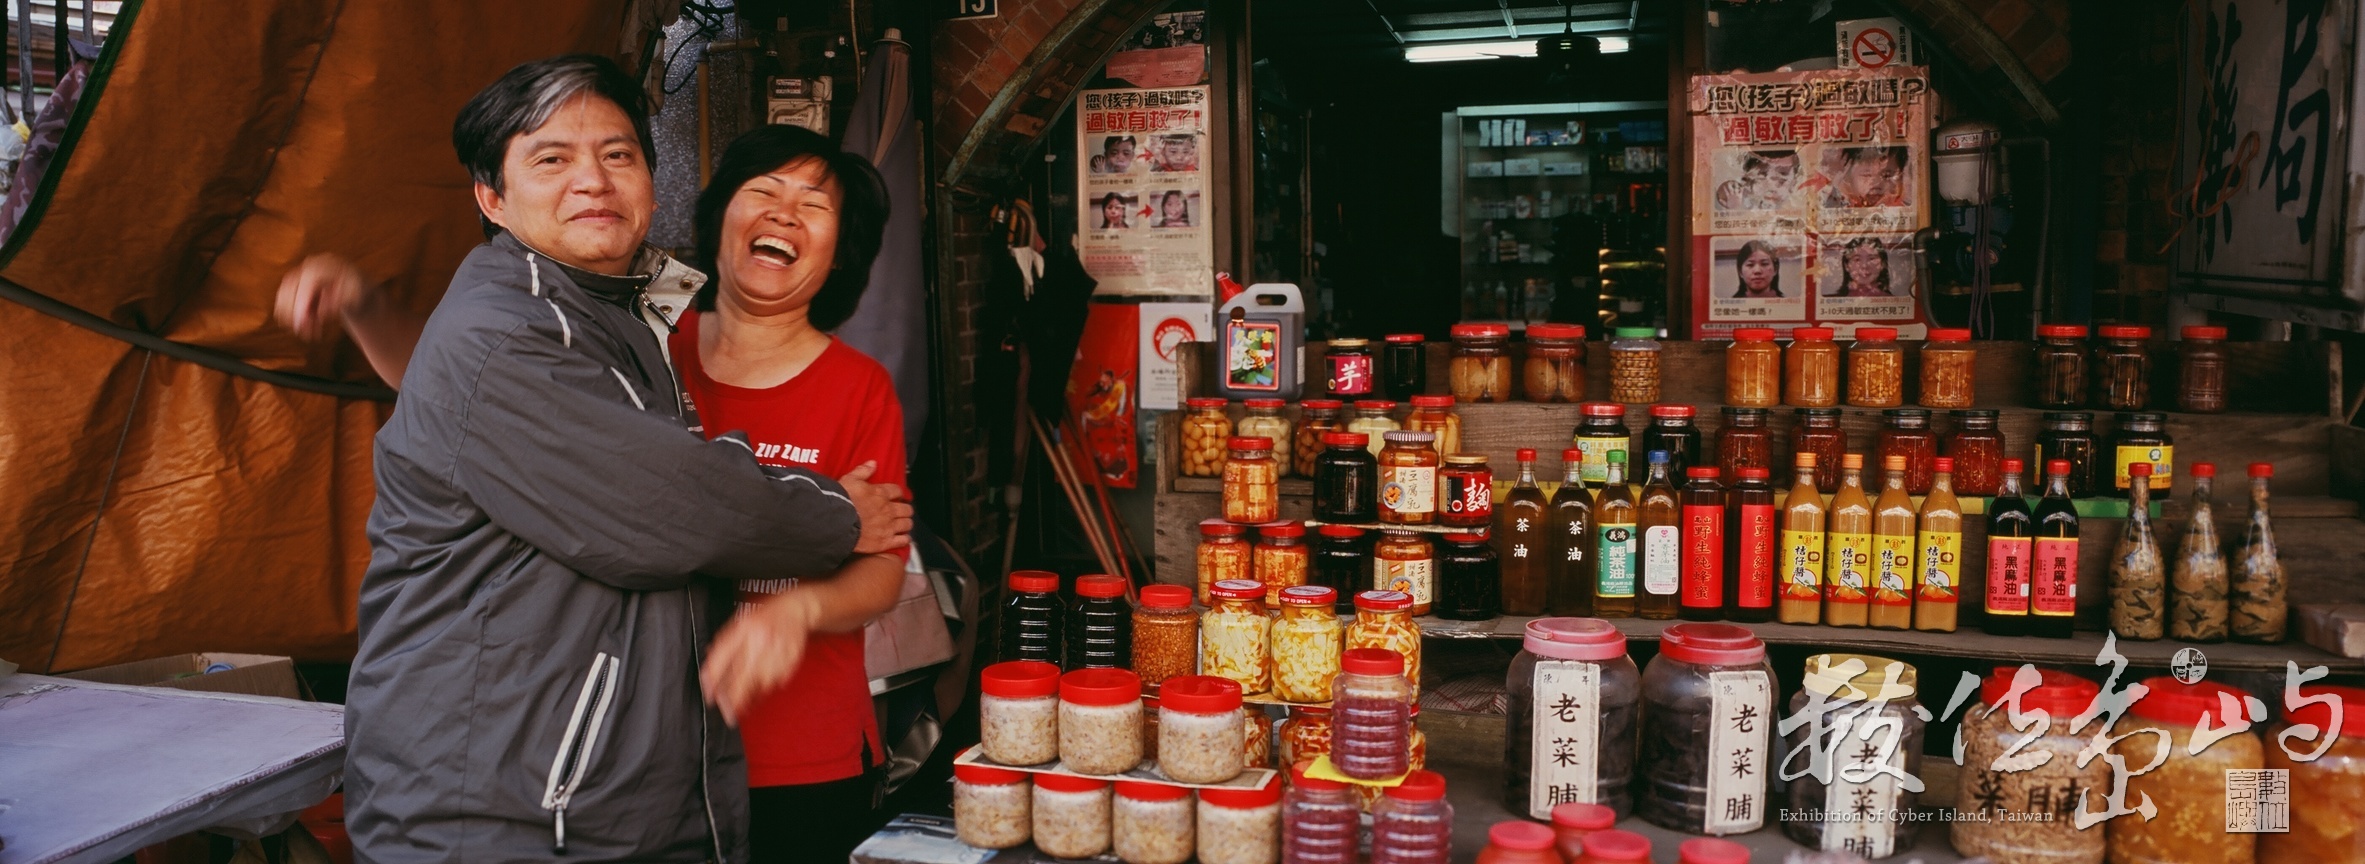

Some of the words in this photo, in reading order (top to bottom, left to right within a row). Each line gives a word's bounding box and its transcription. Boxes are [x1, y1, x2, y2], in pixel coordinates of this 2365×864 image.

[1707, 78, 1929, 113] 您(孩子)過敏嗎?
[1086, 110, 1201, 133] 過敏有救了!
[1722, 112, 1909, 146] 過敏有救了!
[1338, 361, 1361, 391] 芋
[755, 442, 782, 459] ZIP
[1407, 470, 1421, 510] 豆腐乳
[1513, 517, 1530, 558] 茶油
[1567, 520, 1583, 561] 茶油
[1609, 546, 1626, 579] 純茶油
[1693, 524, 1712, 600] 野生純蜂蜜
[1752, 524, 1770, 599] 野生純蜂蜜
[1793, 545, 1807, 578] 桔仔醬
[1841, 547, 1853, 579] 桔仔醬
[1879, 549, 1894, 582] 桔仔醬
[1925, 546, 1939, 579] 桔仔醬
[2003, 556, 2018, 595] 黑麻油
[2052, 557, 2067, 596] 黑麻油
[1416, 562, 1427, 601] 豆腐乳
[1547, 693, 1581, 806] 老菜脯
[1724, 704, 1758, 821] 老菜脯
